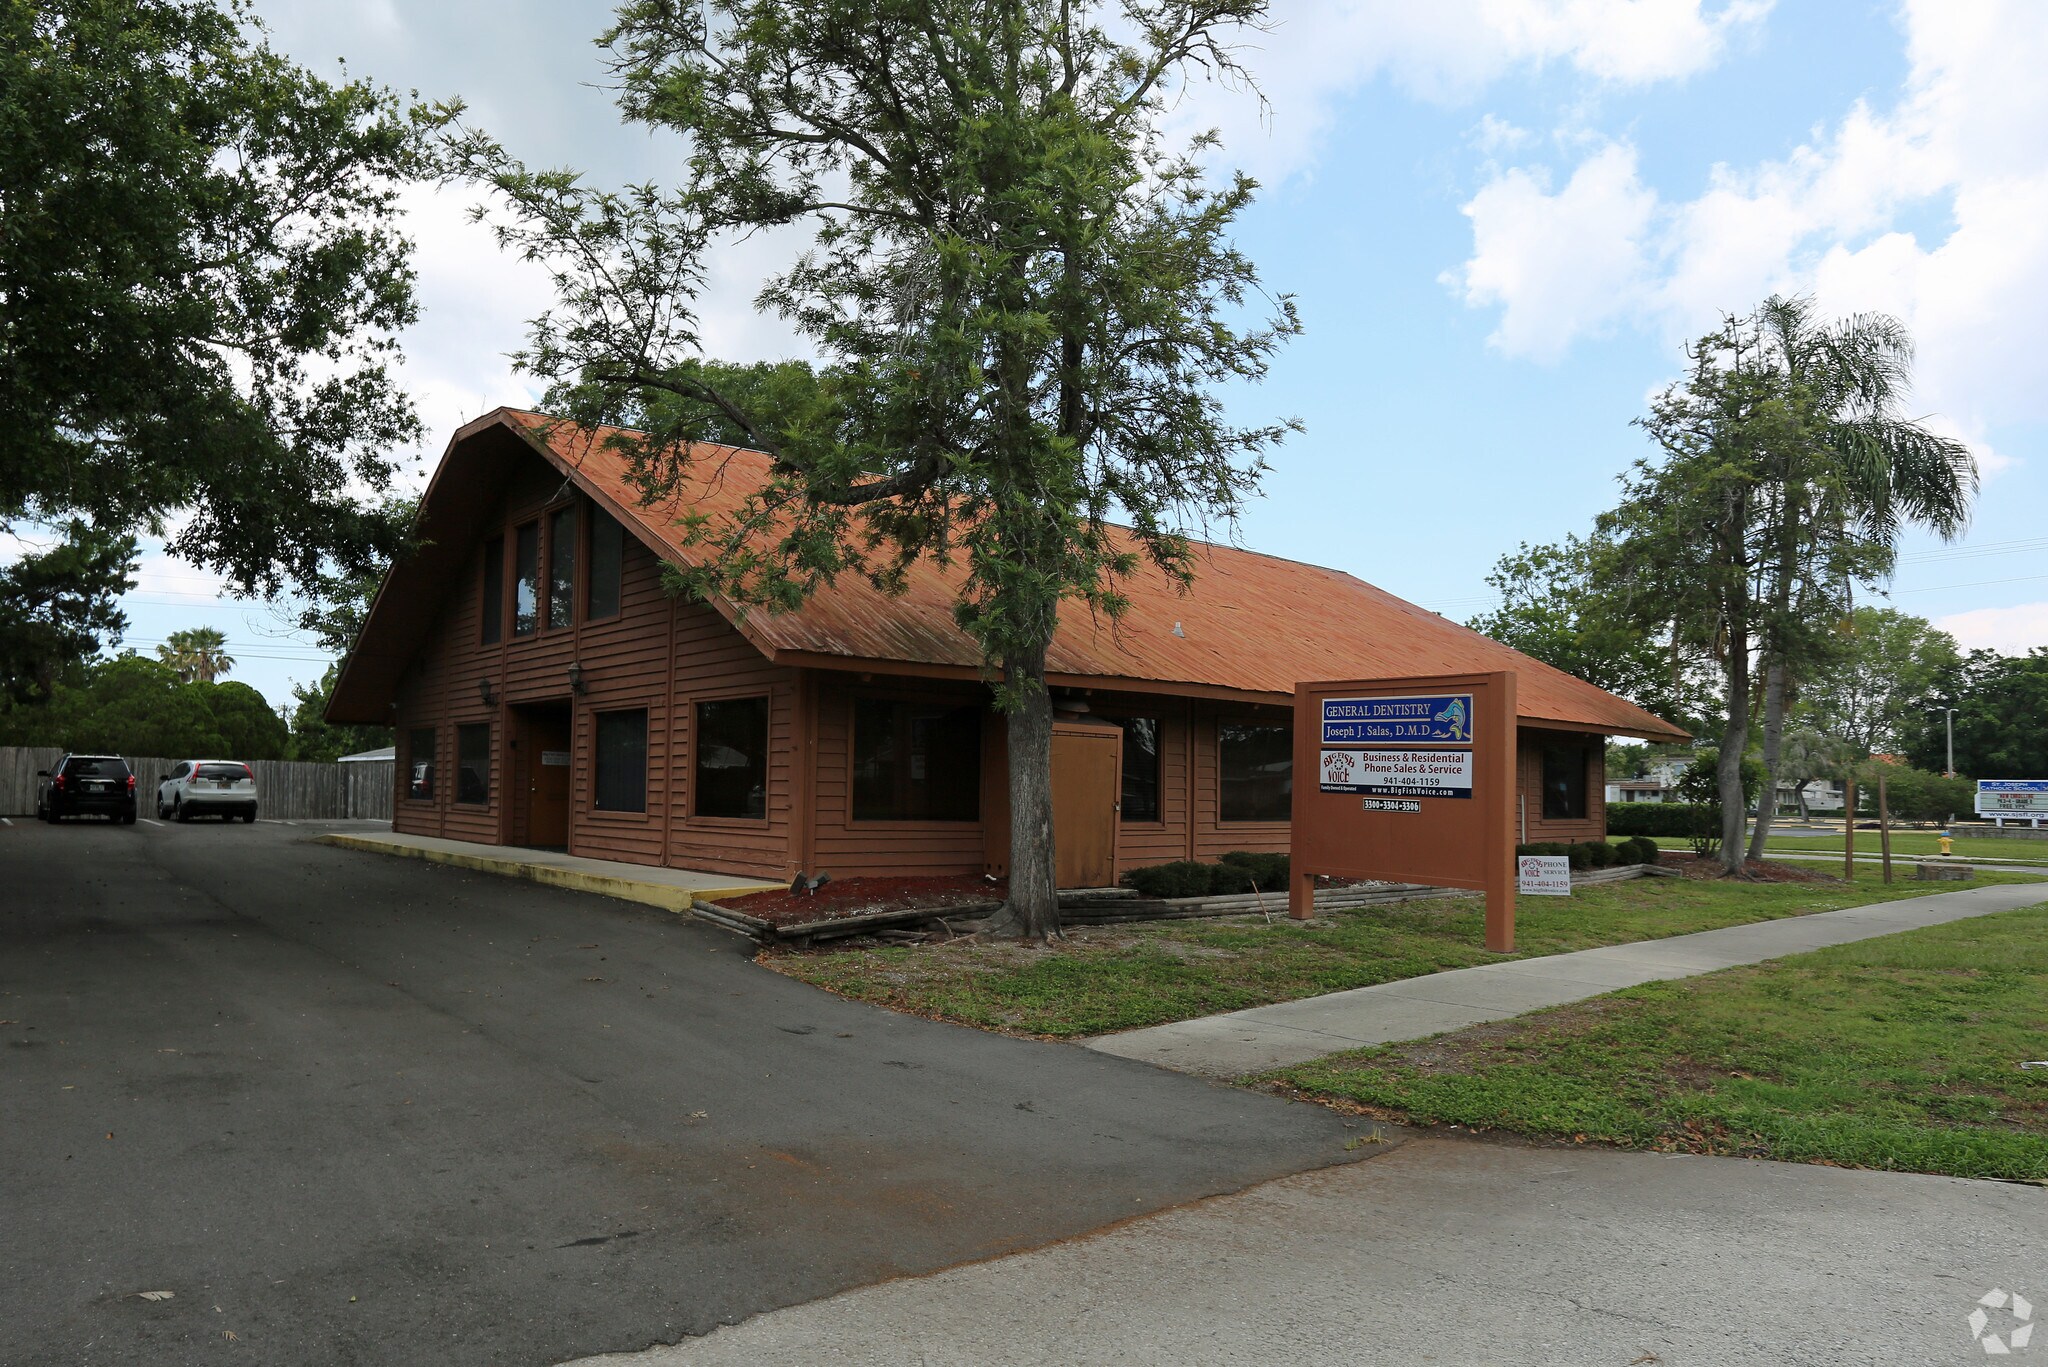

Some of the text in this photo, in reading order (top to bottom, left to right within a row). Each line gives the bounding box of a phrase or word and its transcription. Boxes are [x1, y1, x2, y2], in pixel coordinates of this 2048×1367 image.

[1326, 703, 1431, 717] GENERAL DENTISTRY
[1326, 724, 1431, 739] Joseph J. Salas, D.M.D
[1323, 752, 1355, 768] BIG FISH
[1363, 753, 1464, 763] Business & Residential
[1364, 763, 1462, 774] Phone Sales & Service
[1328, 767, 1350, 783] VOICE
[1383, 777, 1440, 786] 941-404-1159
[1371, 787, 1454, 796] www.BigFishVoice.com
